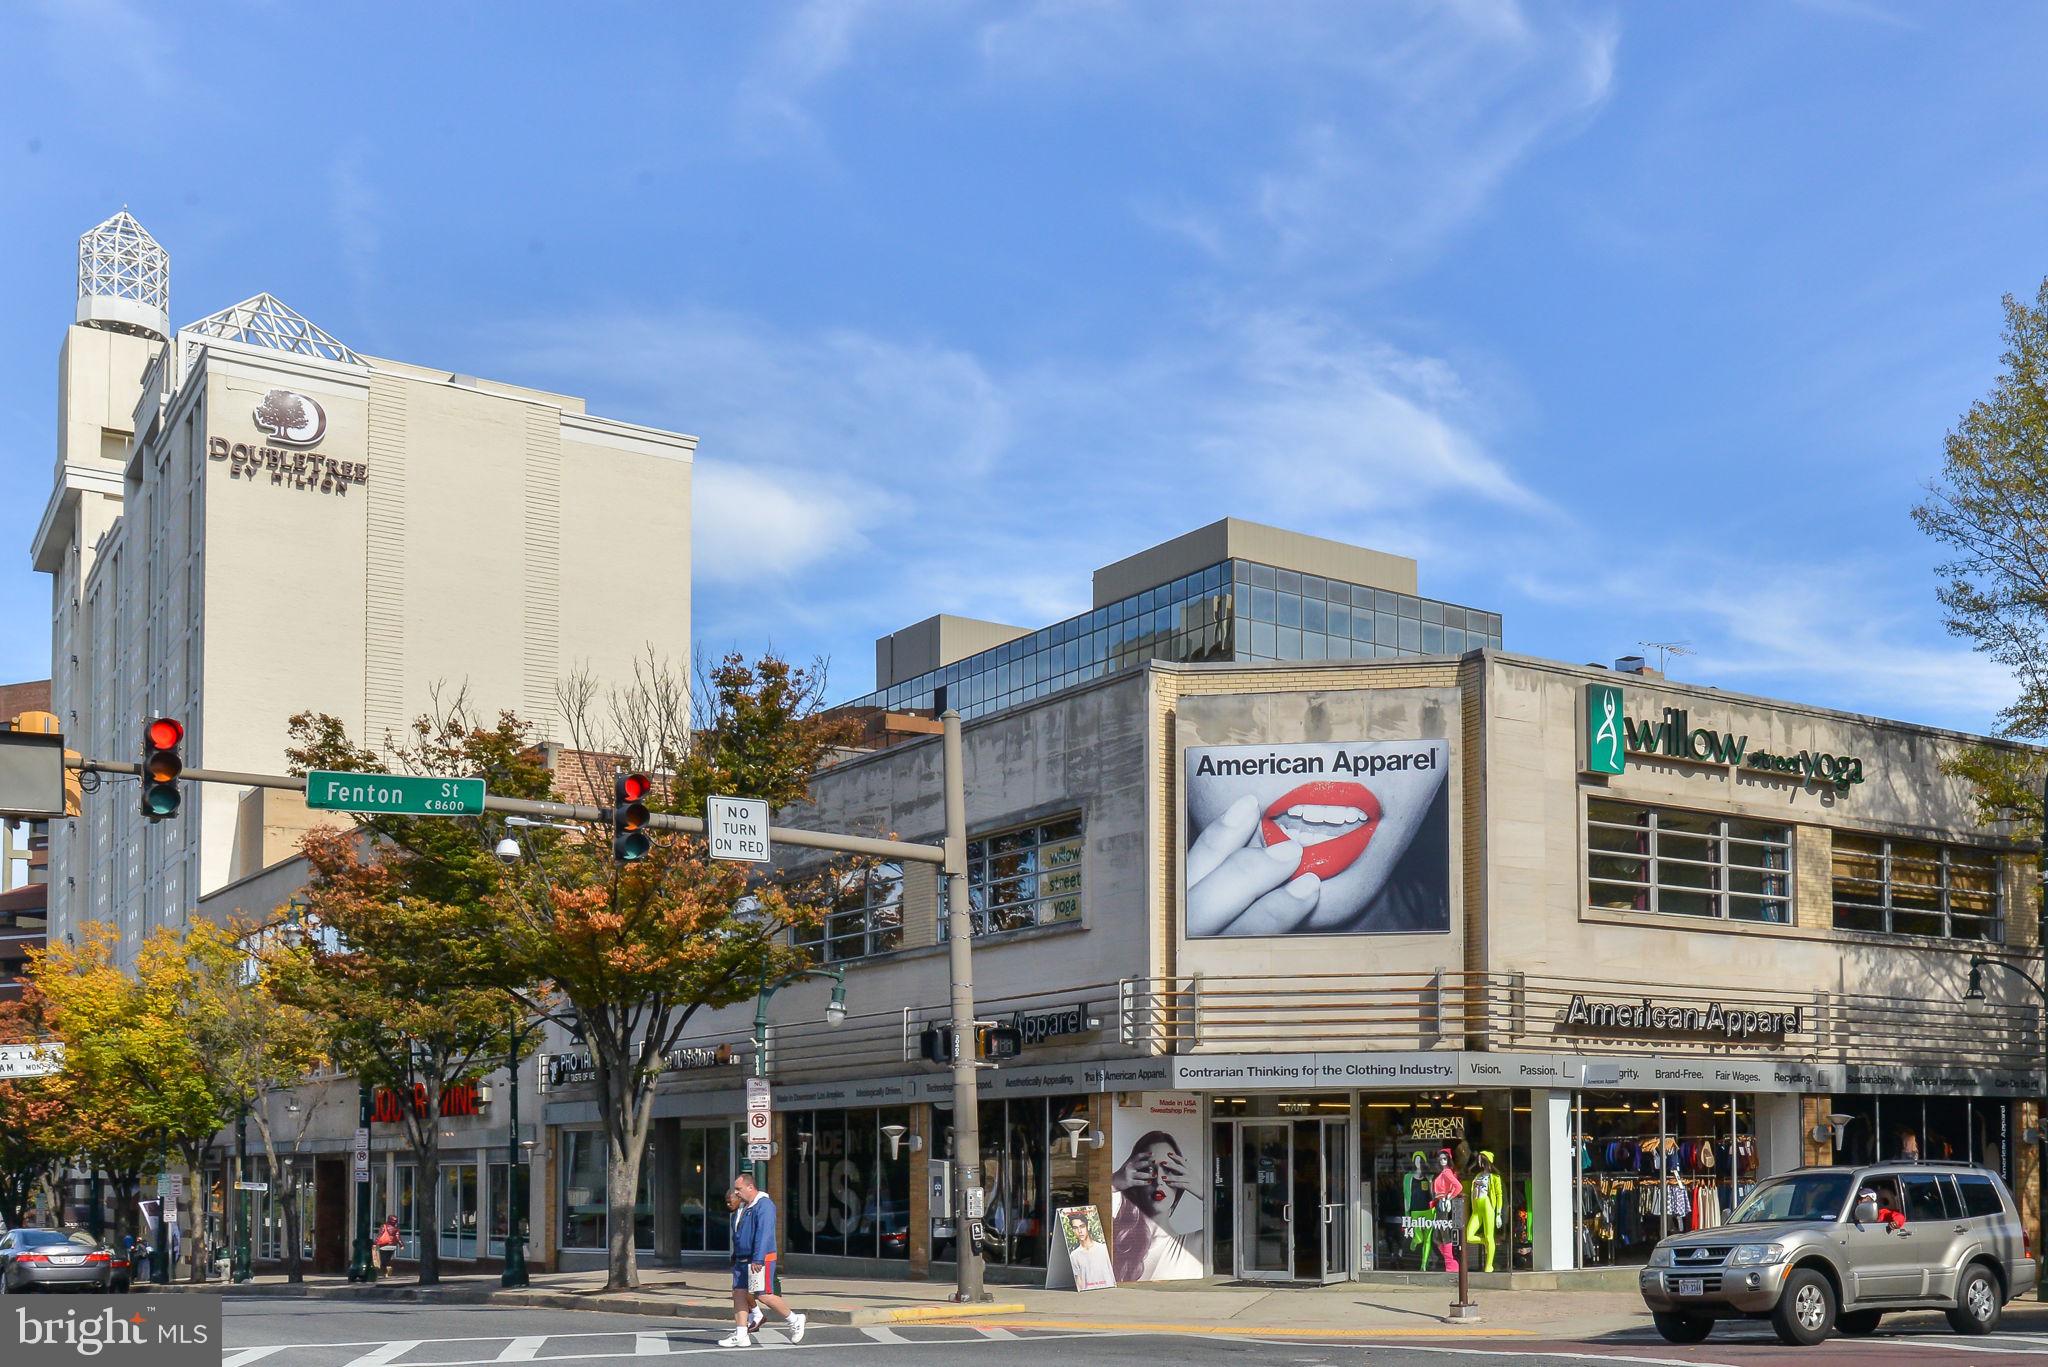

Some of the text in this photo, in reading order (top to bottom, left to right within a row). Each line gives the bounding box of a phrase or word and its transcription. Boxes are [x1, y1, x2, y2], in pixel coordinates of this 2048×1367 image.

[1624, 707, 1864, 793] willow street yoga
[1196, 748, 1436, 777] American Apparel
[327, 781, 459, 804] Fenton St
[434, 800, 464, 811] 8600
[728, 806, 749, 819] NO
[723, 823, 756, 836] TURN
[715, 839, 764, 853] ON RED
[1050, 846, 1081, 864] willow
[1050, 872, 1081, 891] street
[1054, 899, 1076, 917] yoga
[1013, 1003, 1088, 1043] Apparel
[1566, 994, 1803, 1037] American Apparel
[1, 1049, 58, 1060] 2 LAES
[1005, 1075, 1042, 1087] Aesthetically
[1105, 1071, 1136, 1081] American
[1138, 1068, 1167, 1082] Apparel.
[1179, 1063, 1453, 1079] Contrarian Thinking for the Clothing Industry.
[1471, 1064, 1501, 1074] Vision.
[1520, 1065, 1558, 1076] Passion.
[1619, 1068, 1639, 1079] grity.
[1655, 1070, 1704, 1079] Brand-Free.
[1715, 1070, 1731, 1081] Fair
[1732, 1071, 1760, 1083] Wages.
[1774, 1072, 1812, 1084] Recycling.
[1150, 1107, 1182, 1115] Sweatshop
[1160, 1099, 1176, 1107] Made
[1177, 1099, 1183, 1107] in
[1411, 1117, 1464, 1130] AMERICAN
[1411, 1128, 1457, 1140] APPAREL
[1401, 1216, 1453, 1230] Hallowee
